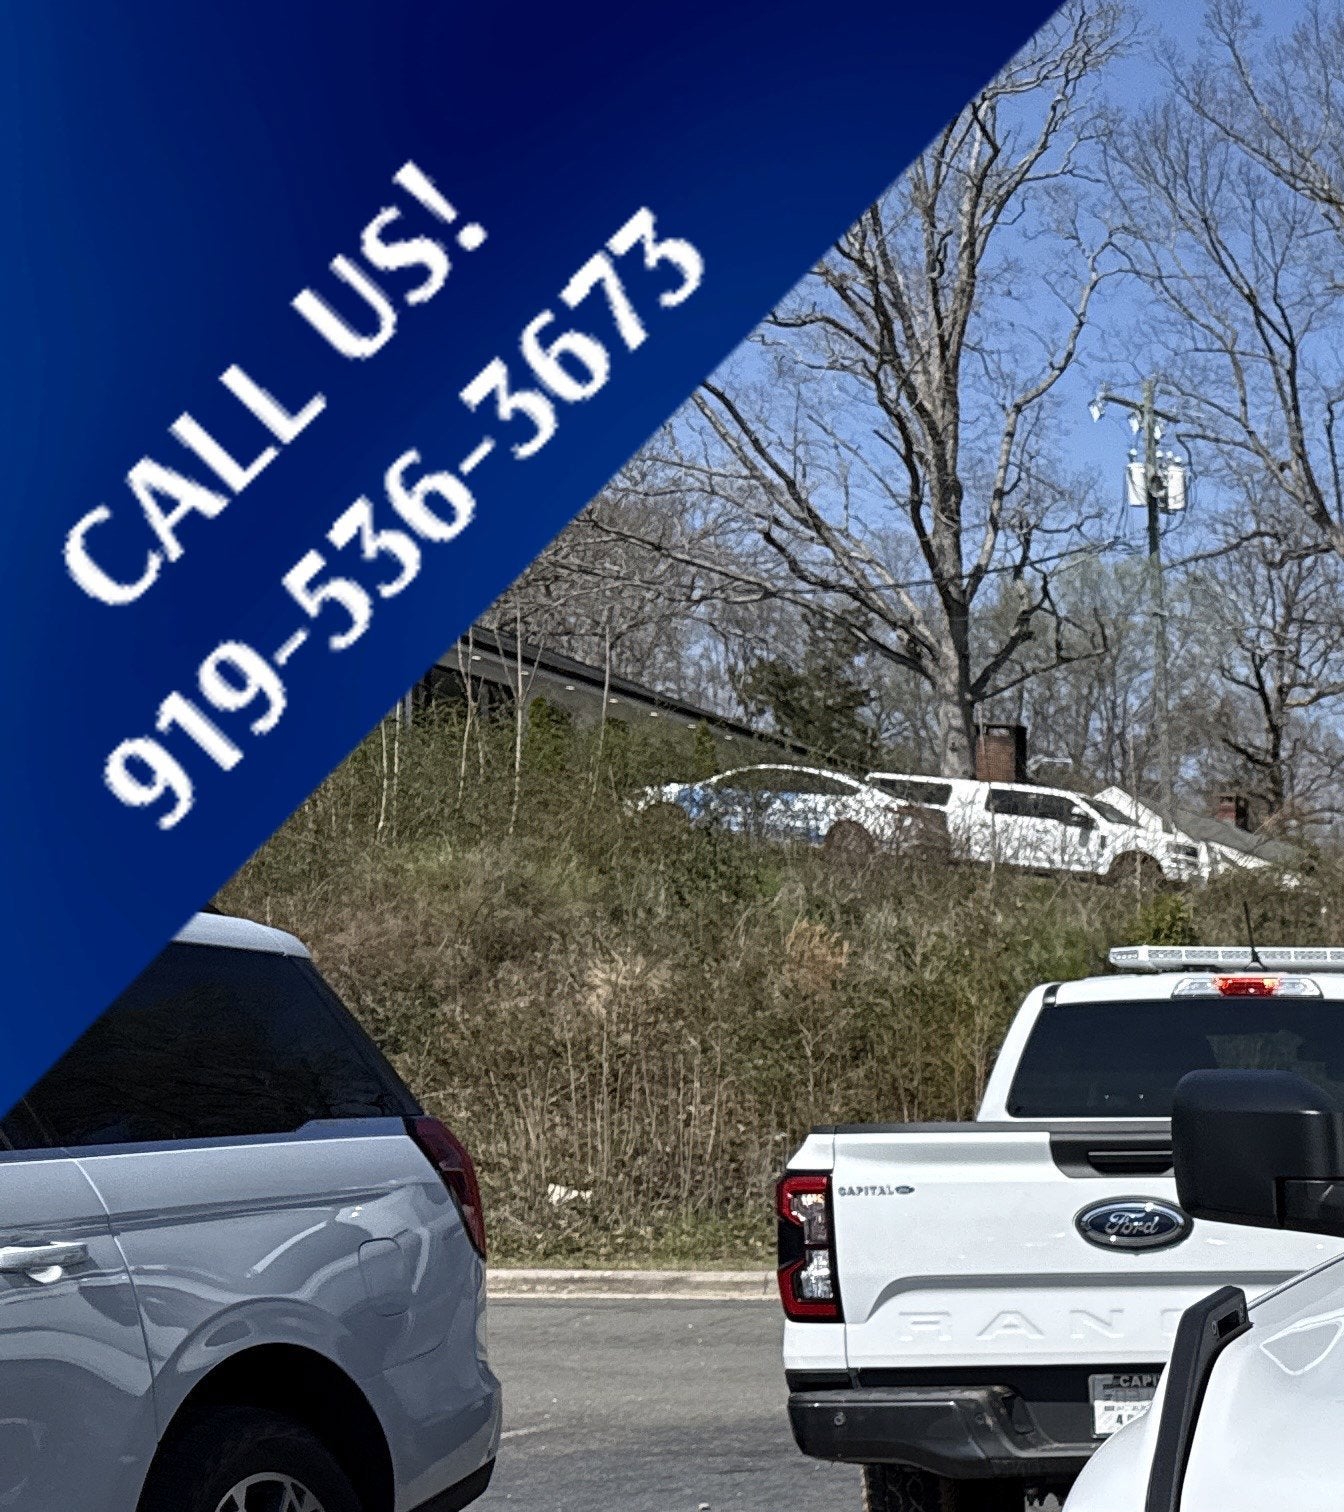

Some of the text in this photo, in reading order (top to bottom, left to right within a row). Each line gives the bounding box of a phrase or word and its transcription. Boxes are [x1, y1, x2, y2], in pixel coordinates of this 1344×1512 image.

[838, 1184, 895, 1197] CAPITAL
[1104, 1211, 1159, 1235] Ford
[898, 1307, 1183, 1341] RAN
[1119, 1374, 1160, 1388] CAPI
